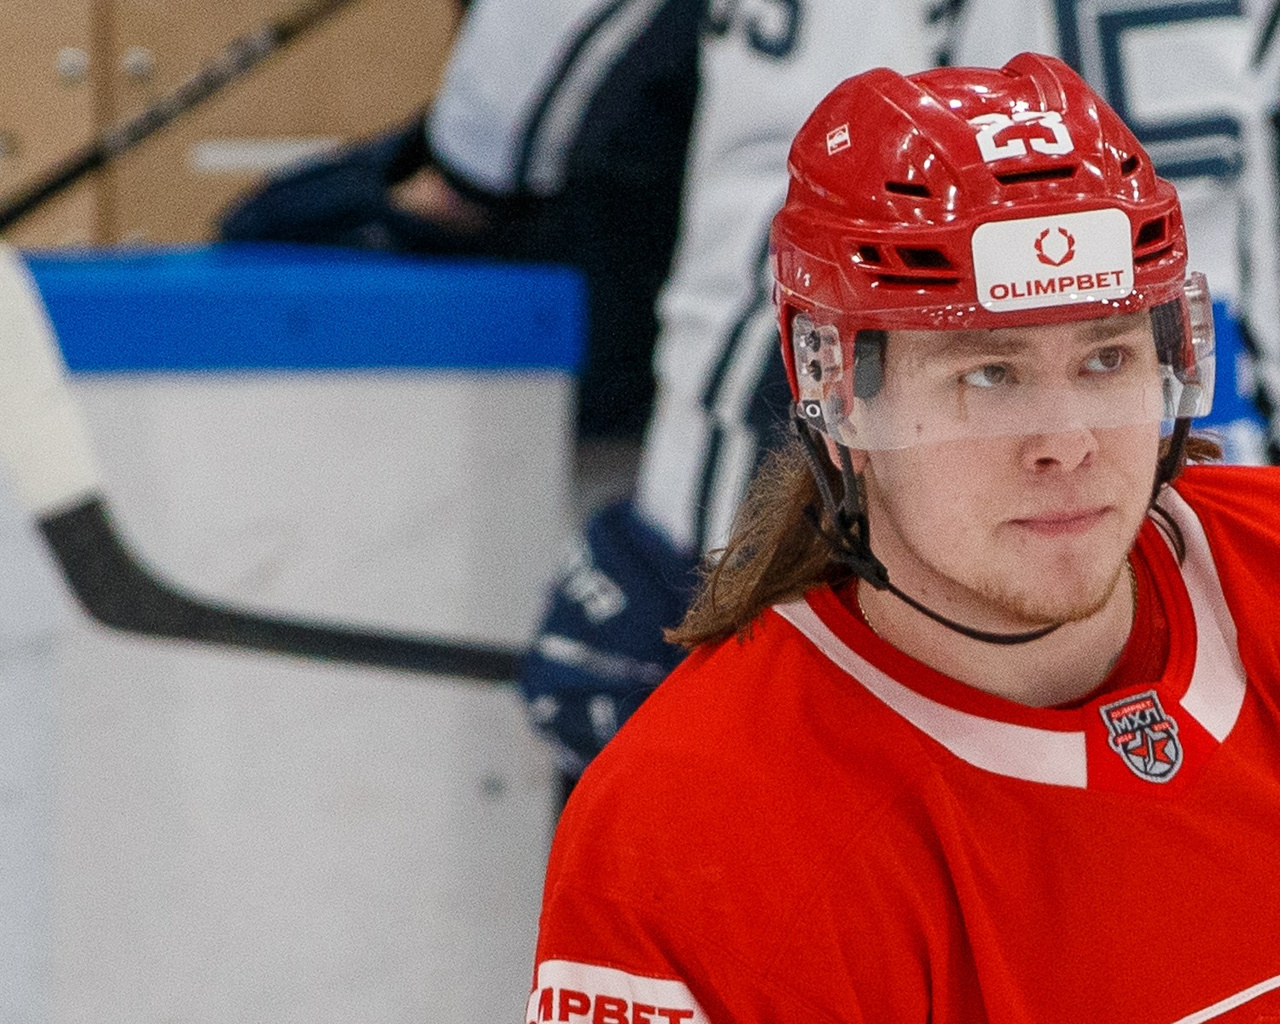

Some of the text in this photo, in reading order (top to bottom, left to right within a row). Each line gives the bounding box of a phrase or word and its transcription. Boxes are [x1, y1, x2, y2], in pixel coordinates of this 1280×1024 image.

[965, 111, 1075, 163] 23
[989, 270, 1125, 301] OLIMPBET
[1111, 708, 1163, 735] МХЛ
